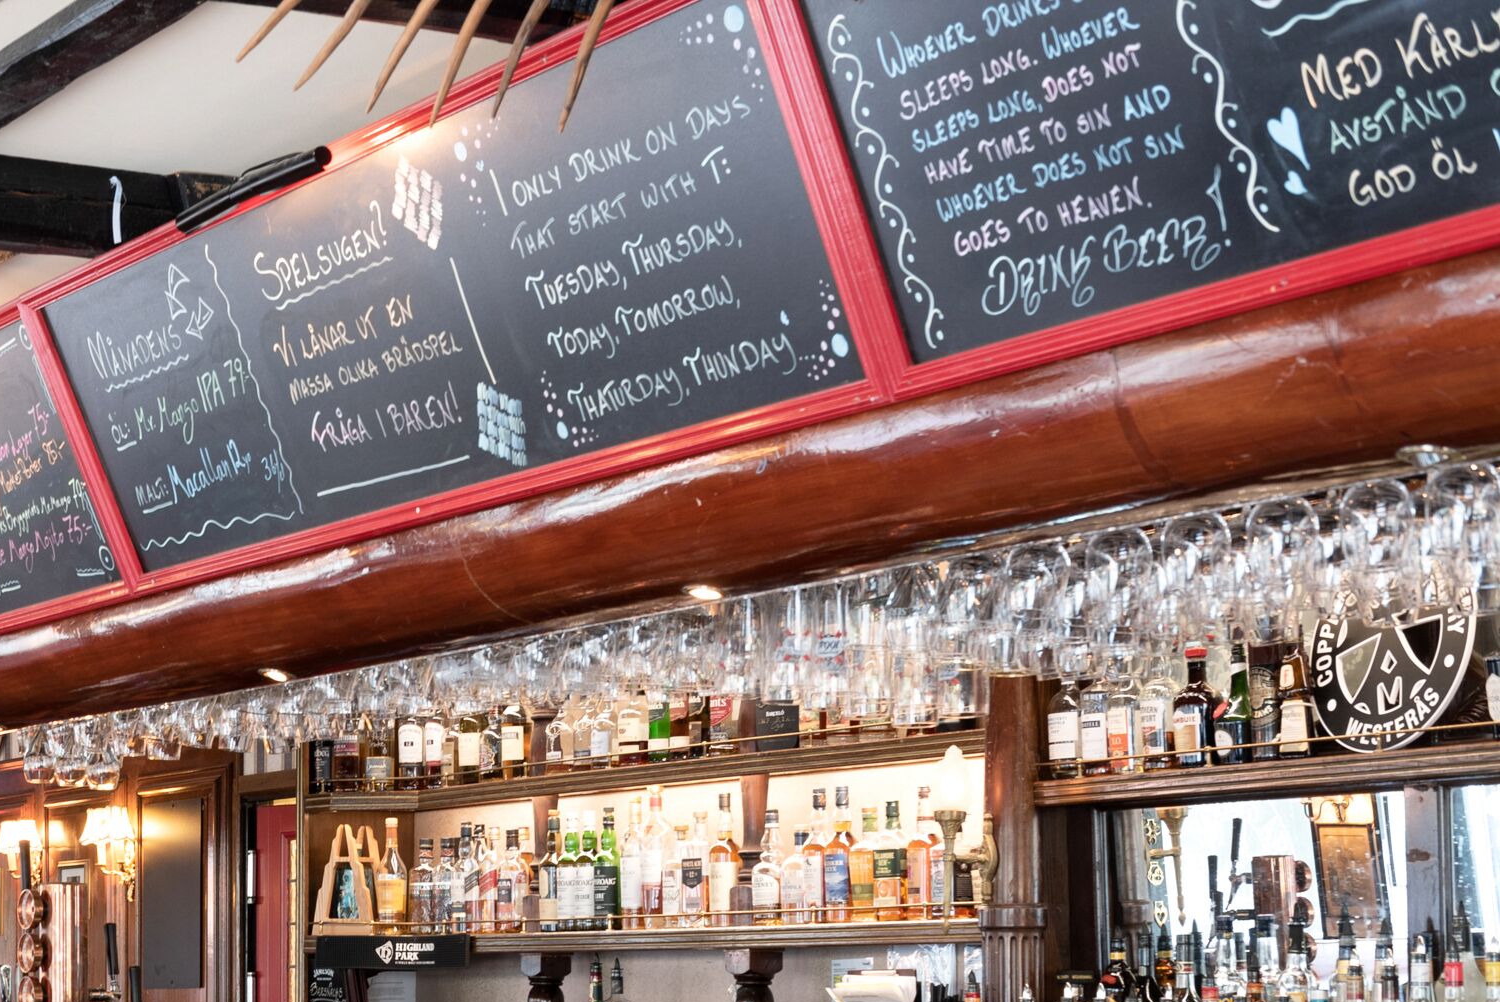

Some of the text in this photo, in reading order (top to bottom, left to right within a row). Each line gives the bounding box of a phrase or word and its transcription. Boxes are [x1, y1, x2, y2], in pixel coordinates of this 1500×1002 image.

[877, 22, 976, 79] WHOEVER
[900, 8, 1140, 120] SLEEPS LONG. WHOEVER
[1301, 48, 1382, 108] MED
[912, 108, 979, 152] SLEEPS
[1042, 65, 1094, 102] DOES
[1102, 43, 1141, 79] NOT
[925, 85, 1171, 184] HAVE TIME TO SIN AND
[1330, 85, 1467, 154] AVSTÅND
[489, 95, 752, 216] I ONLY DRINK ON DAYS
[936, 124, 1185, 222] WHOEVER DOES NOT SIN
[1349, 137, 1477, 206] GOD ÖL
[253, 200, 387, 300] SPELSUGEN?
[510, 217, 556, 258] THAT
[568, 192, 626, 235] START
[641, 172, 696, 210] WITH
[954, 176, 1153, 256] GOES TO HEAVEN.
[525, 217, 743, 310] TUESDAY, THURSDAY,
[981, 236, 1096, 315] DRINK
[87, 324, 182, 379] MÅNADENS
[273, 295, 414, 368] VI LÅNAR UT EN
[547, 275, 741, 359] TODAY, TOMORROW,
[157, 396, 199, 445] Mango
[197, 369, 225, 413] IPA
[290, 373, 334, 405] MASSA
[338, 358, 379, 386] OLIKA
[311, 407, 373, 452] FRÅGA
[387, 380, 463, 436] BAREN!
[567, 333, 798, 422] THATURDAY, THUNDAY
[167, 447, 230, 504] Macallan
[395, 943, 435, 951] HIGHLAND
[395, 951, 419, 960] PARK
